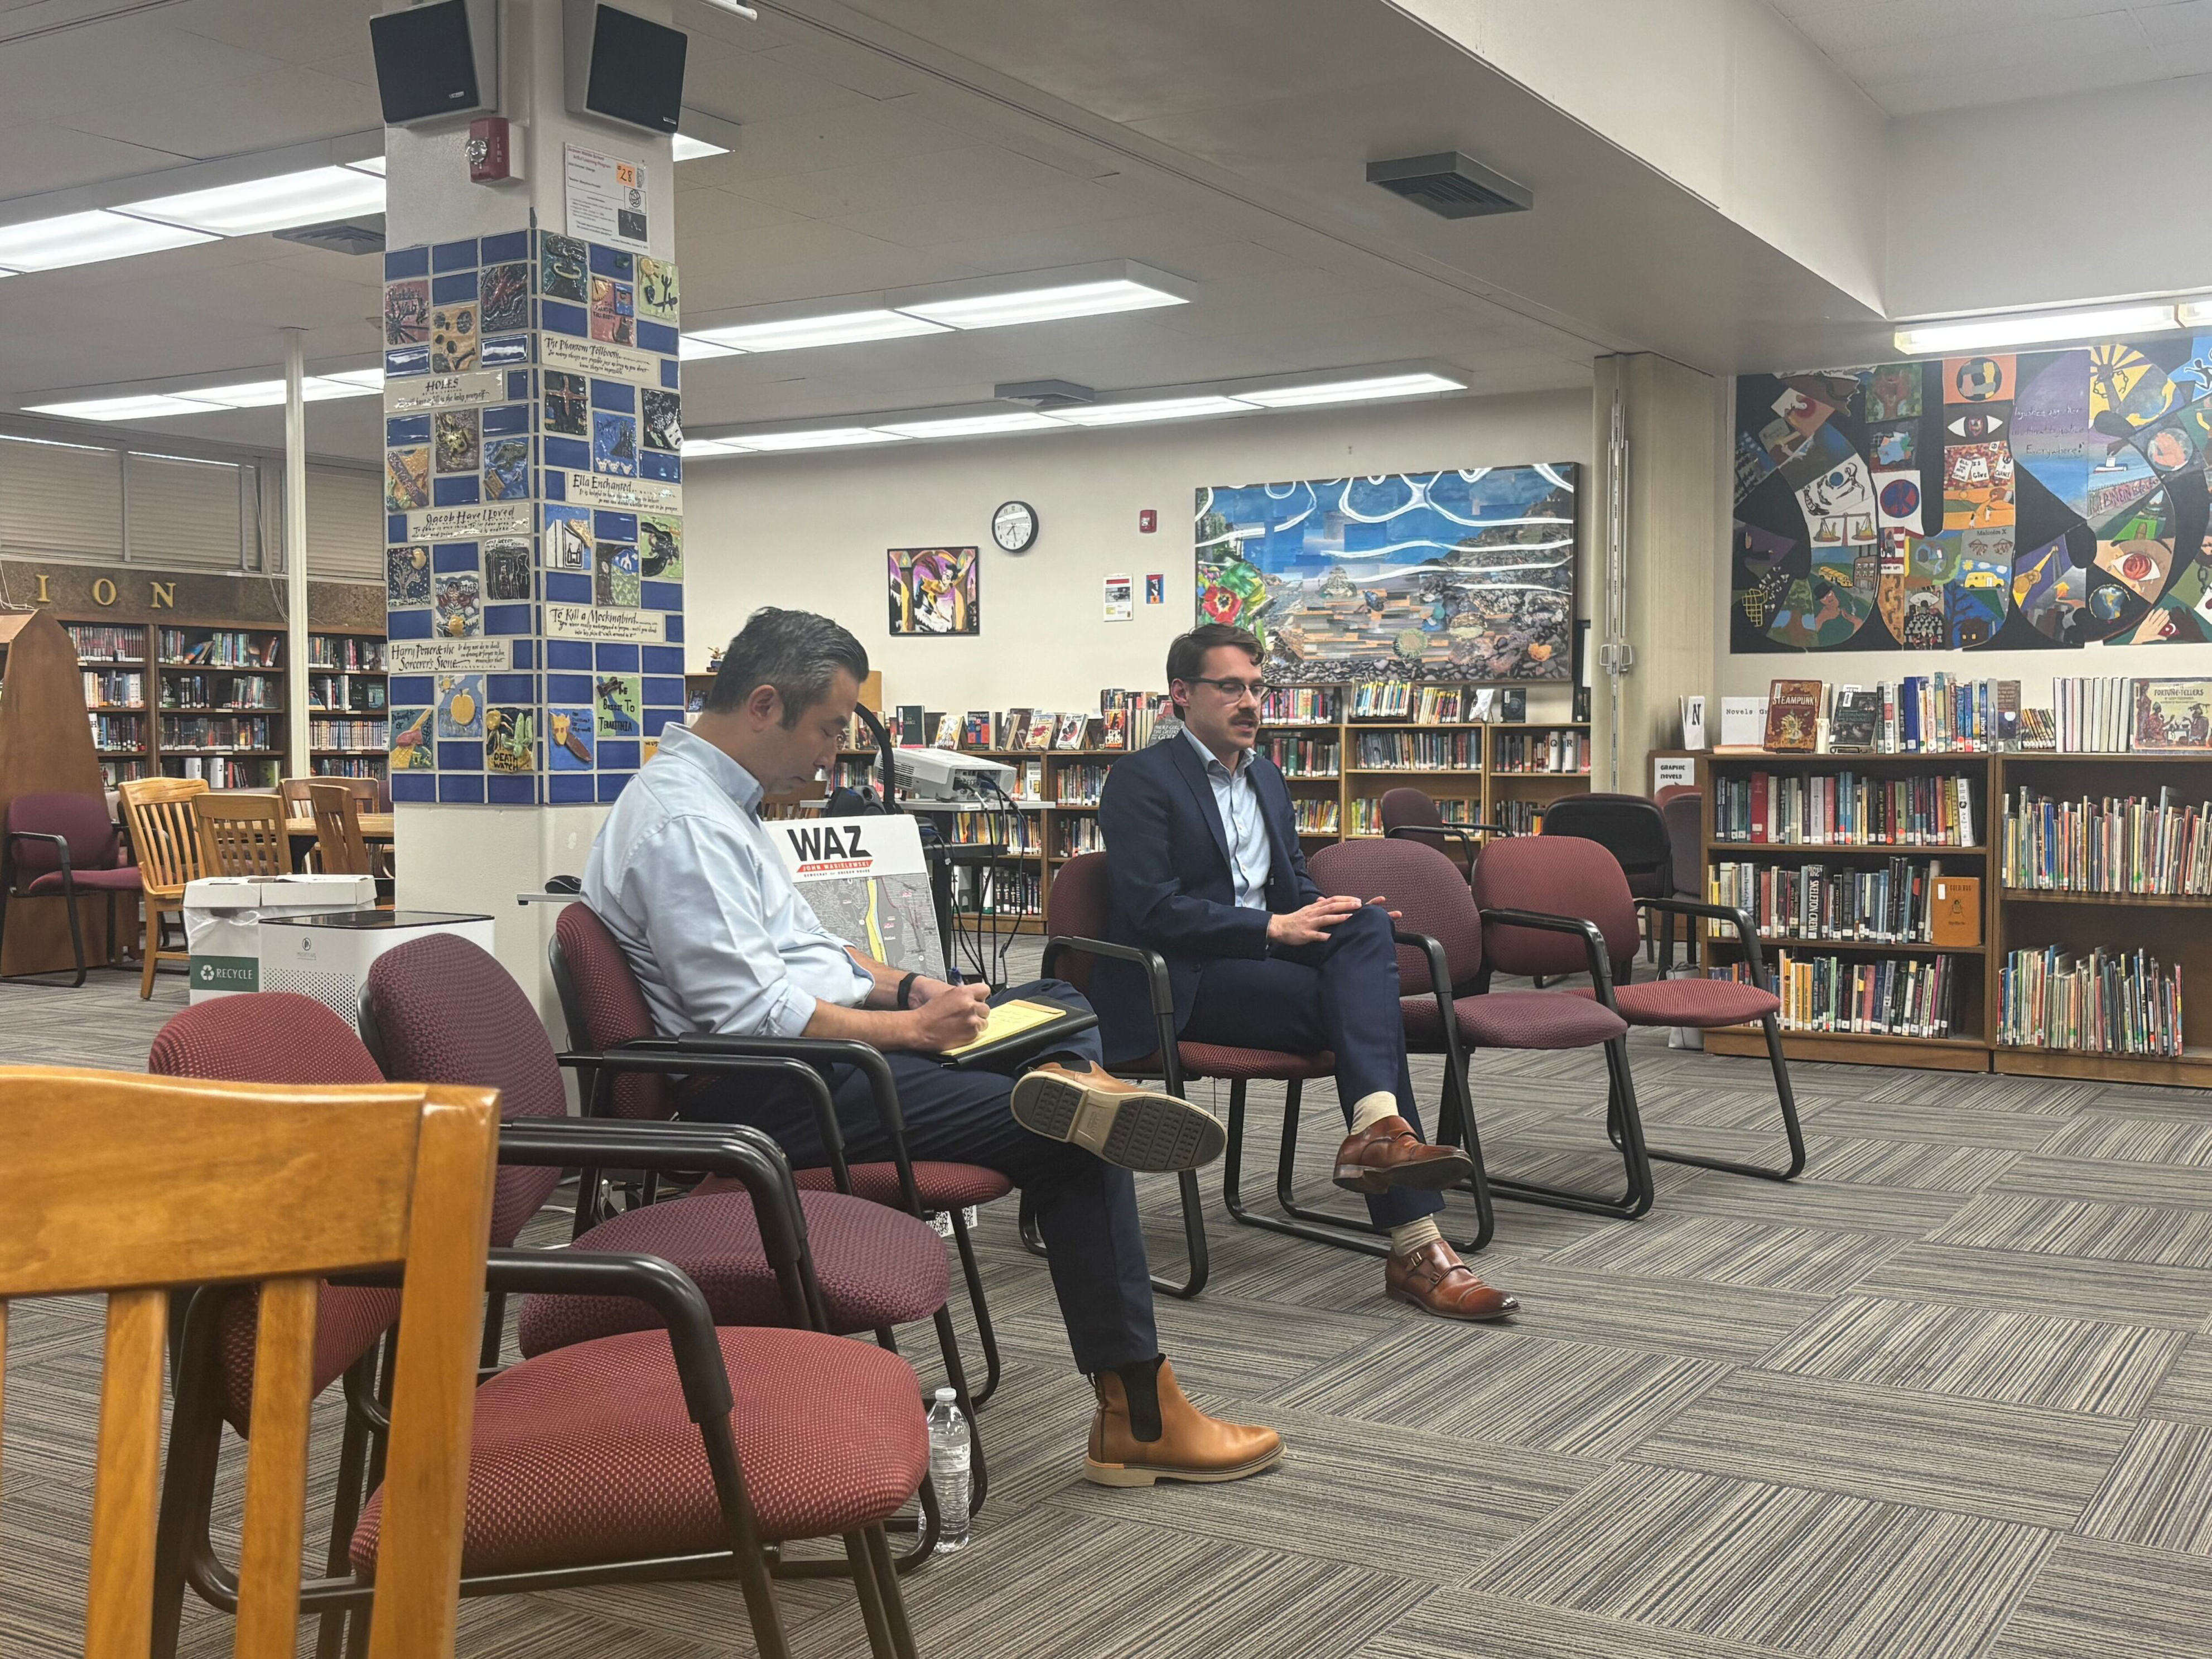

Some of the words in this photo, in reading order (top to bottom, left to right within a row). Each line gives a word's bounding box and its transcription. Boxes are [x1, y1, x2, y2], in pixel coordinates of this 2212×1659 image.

[544, 337, 557, 348] The
[560, 339, 588, 352] Phantom
[425, 378, 459, 391] HOLES
[573, 474, 590, 488] Ella
[591, 476, 632, 493] Enchanted
[426, 512, 456, 527] Jacob
[457, 511, 481, 524] Have
[483, 509, 486, 520] I
[489, 506, 514, 520] Loved
[550, 608, 564, 623] To
[566, 608, 579, 621] Kill
[581, 613, 586, 621] a
[587, 609, 637, 625] Mockingbird
[392, 644, 415, 659] Harry
[435, 656, 457, 670] Stone
[1692, 703, 1701, 726] N
[1550, 739, 1558, 747] Q
[1567, 739, 1573, 747] R
[786, 826, 872, 861] WAZ
[1809, 880, 1819, 912] SKELETON
[1808, 913, 1819, 932] CREW
[216, 968, 253, 980] RECYCLE
